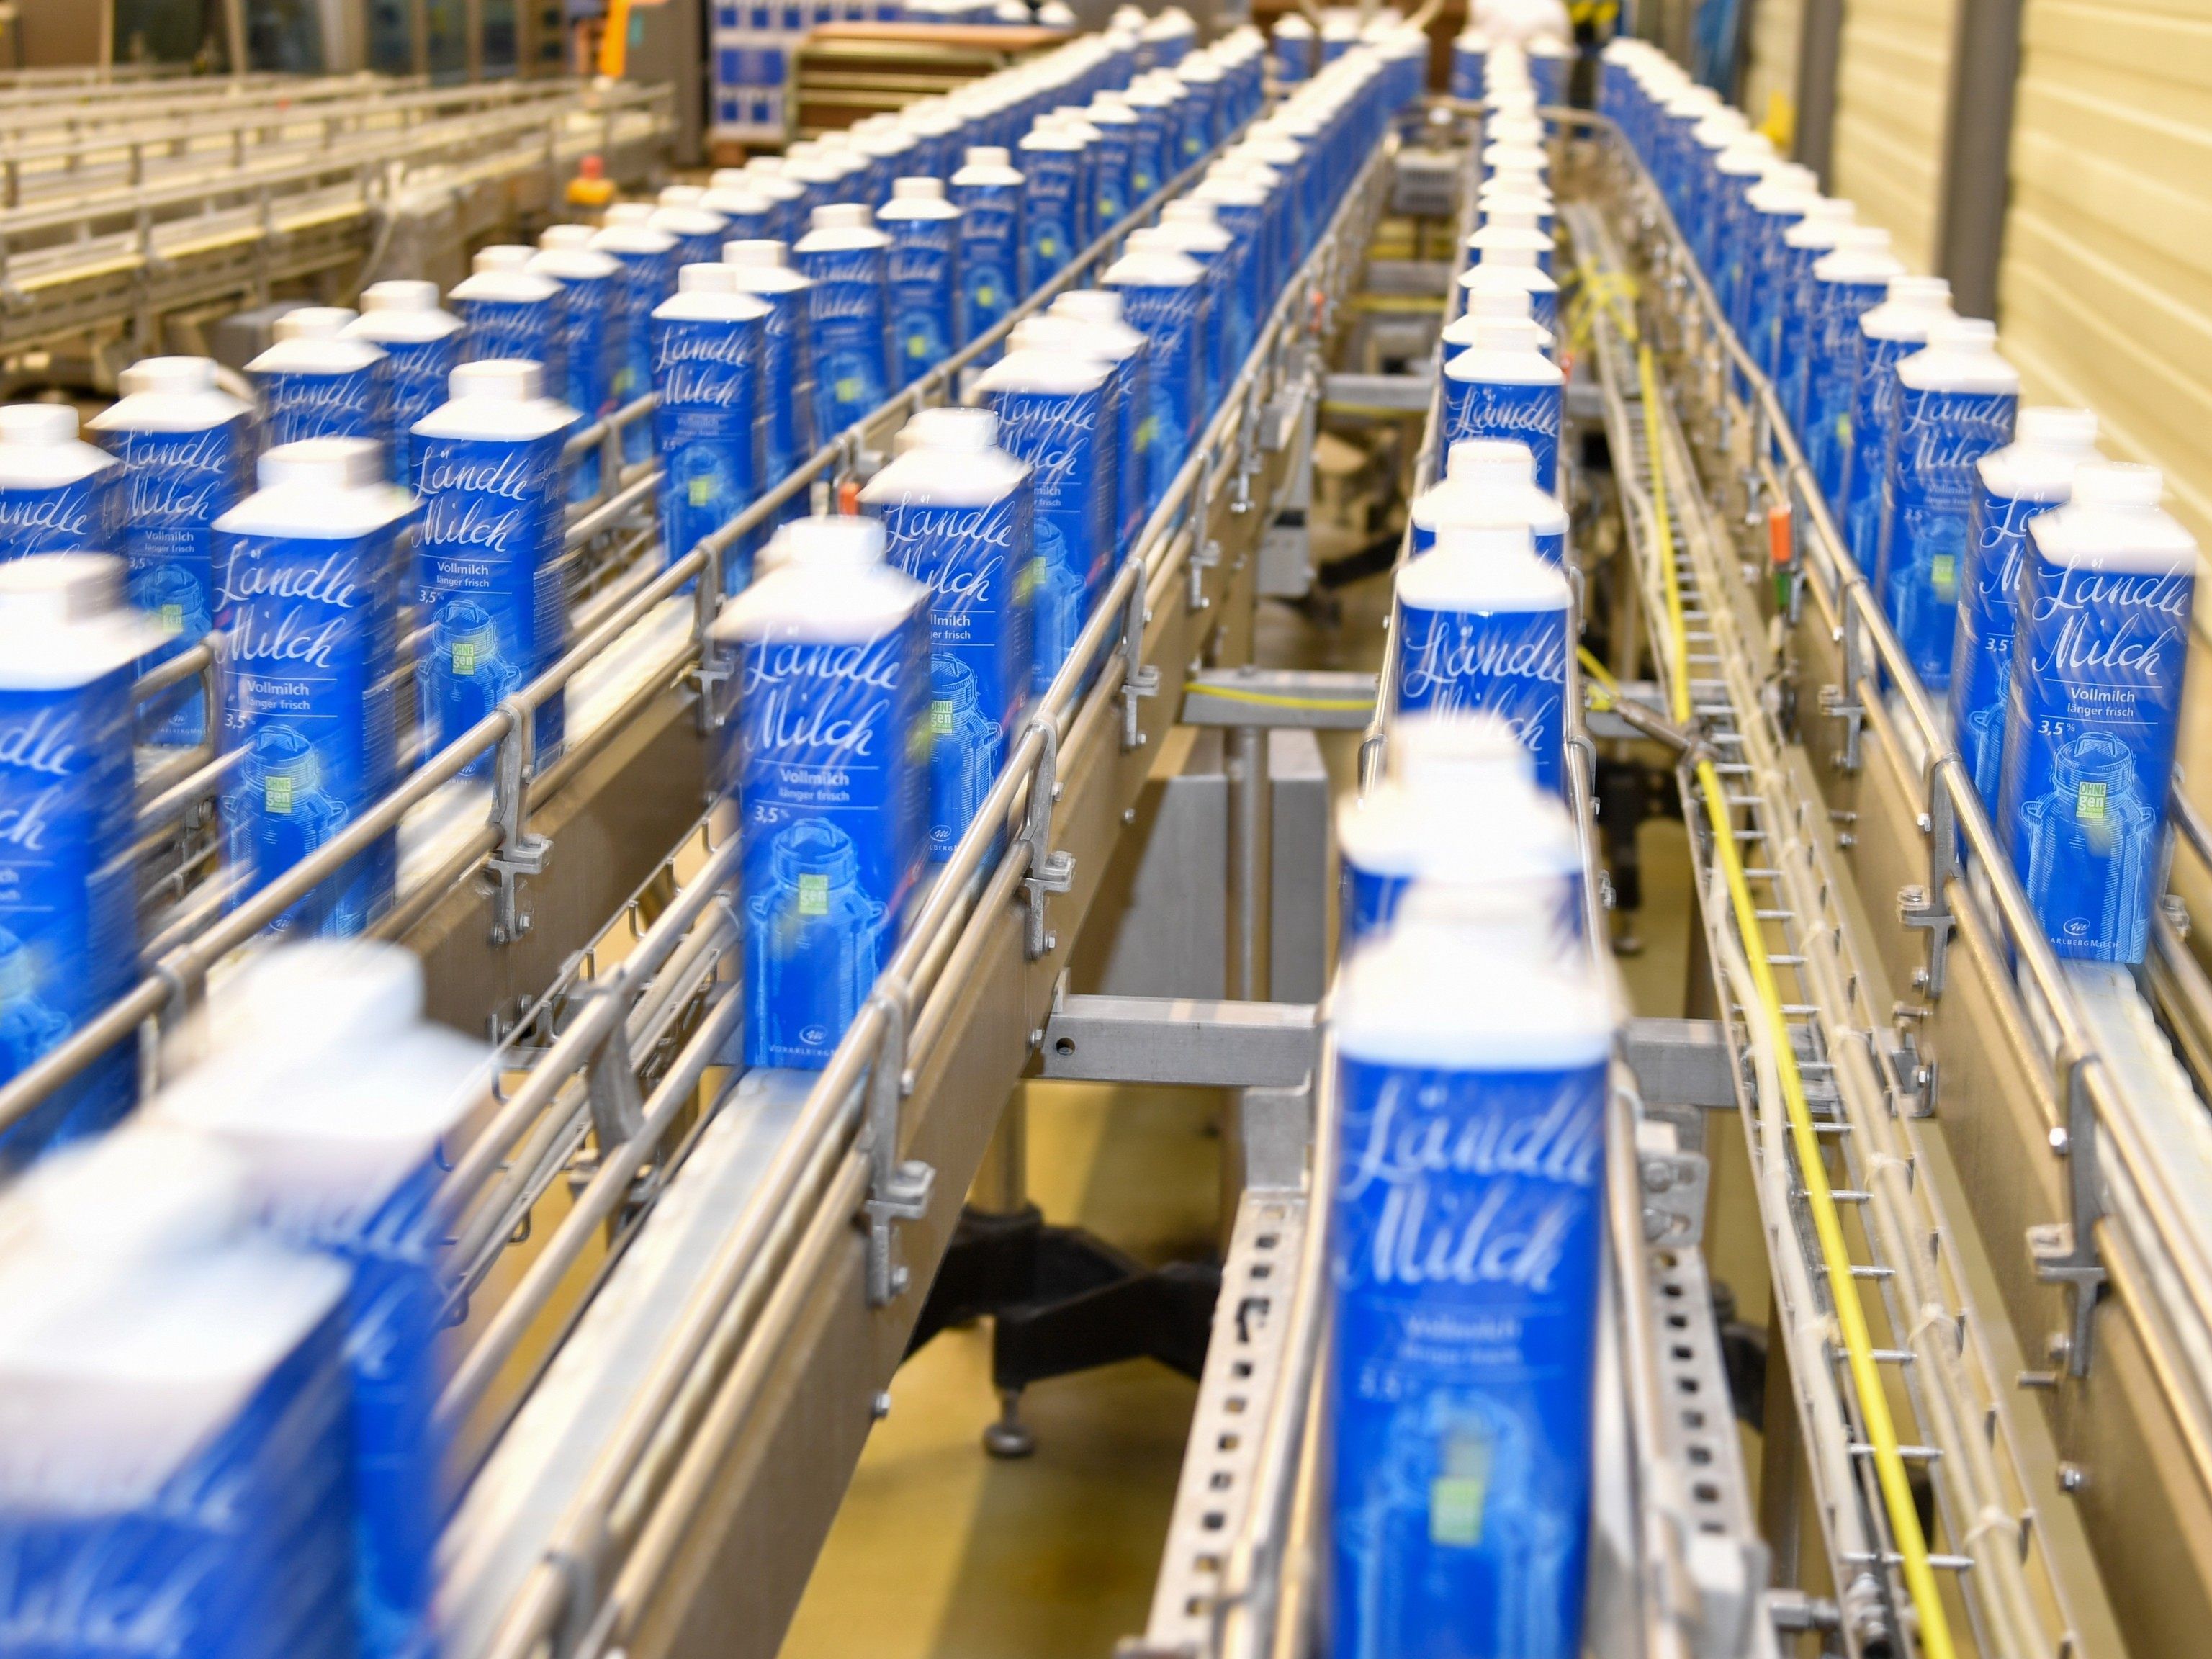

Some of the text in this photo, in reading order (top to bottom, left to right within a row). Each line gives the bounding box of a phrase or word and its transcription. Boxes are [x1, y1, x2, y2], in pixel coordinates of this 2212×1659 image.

[652, 325, 748, 374] Ländle
[276, 371, 375, 415] Ländle
[655, 364, 750, 408] Milch
[994, 385, 1098, 431] Ländle
[115, 426, 228, 477] Ländle
[410, 446, 531, 503] Ländle
[125, 471, 220, 521] Milch
[1034, 486, 1061, 495] milch
[0, 486, 90, 535] ndle
[412, 498, 520, 553] Milch
[882, 490, 1015, 554] Ländle
[145, 530, 194, 543] Vollmilch
[171, 544, 195, 553] frisch
[212, 539, 359, 612] Ländle
[436, 561, 489, 575] Vollmilch
[436, 575, 490, 588] länger frisch
[900, 544, 1004, 601] Milch
[2032, 554, 2191, 621] Ländle
[215, 604, 346, 668] Milch
[930, 614, 971, 627] llmilch
[944, 629, 971, 639] frisch
[453, 644, 473, 655] OHNE
[2031, 611, 2177, 675] Milch
[453, 655, 473, 668] gen
[744, 623, 904, 695] Ländle
[1403, 621, 1567, 698] Ländle
[246, 695, 310, 710] länger frisch
[247, 680, 310, 696] Vollmilch
[2070, 687, 2136, 703] Vollmilch
[744, 685, 890, 756] Milch
[930, 712, 952, 727] gen
[931, 701, 952, 713] OHNE
[2067, 703, 2134, 717] länger frisch
[0, 706, 77, 776] dle
[266, 776, 291, 791] OHNE
[780, 768, 850, 786] Vollmilch
[2080, 783, 2106, 796] OHNE
[266, 790, 291, 807] gen
[778, 787, 850, 803] länger frisch
[2078, 795, 2104, 811] gen
[1341, 1076, 1603, 1202] Ländle
[1331, 1179, 1584, 1293] Milch
